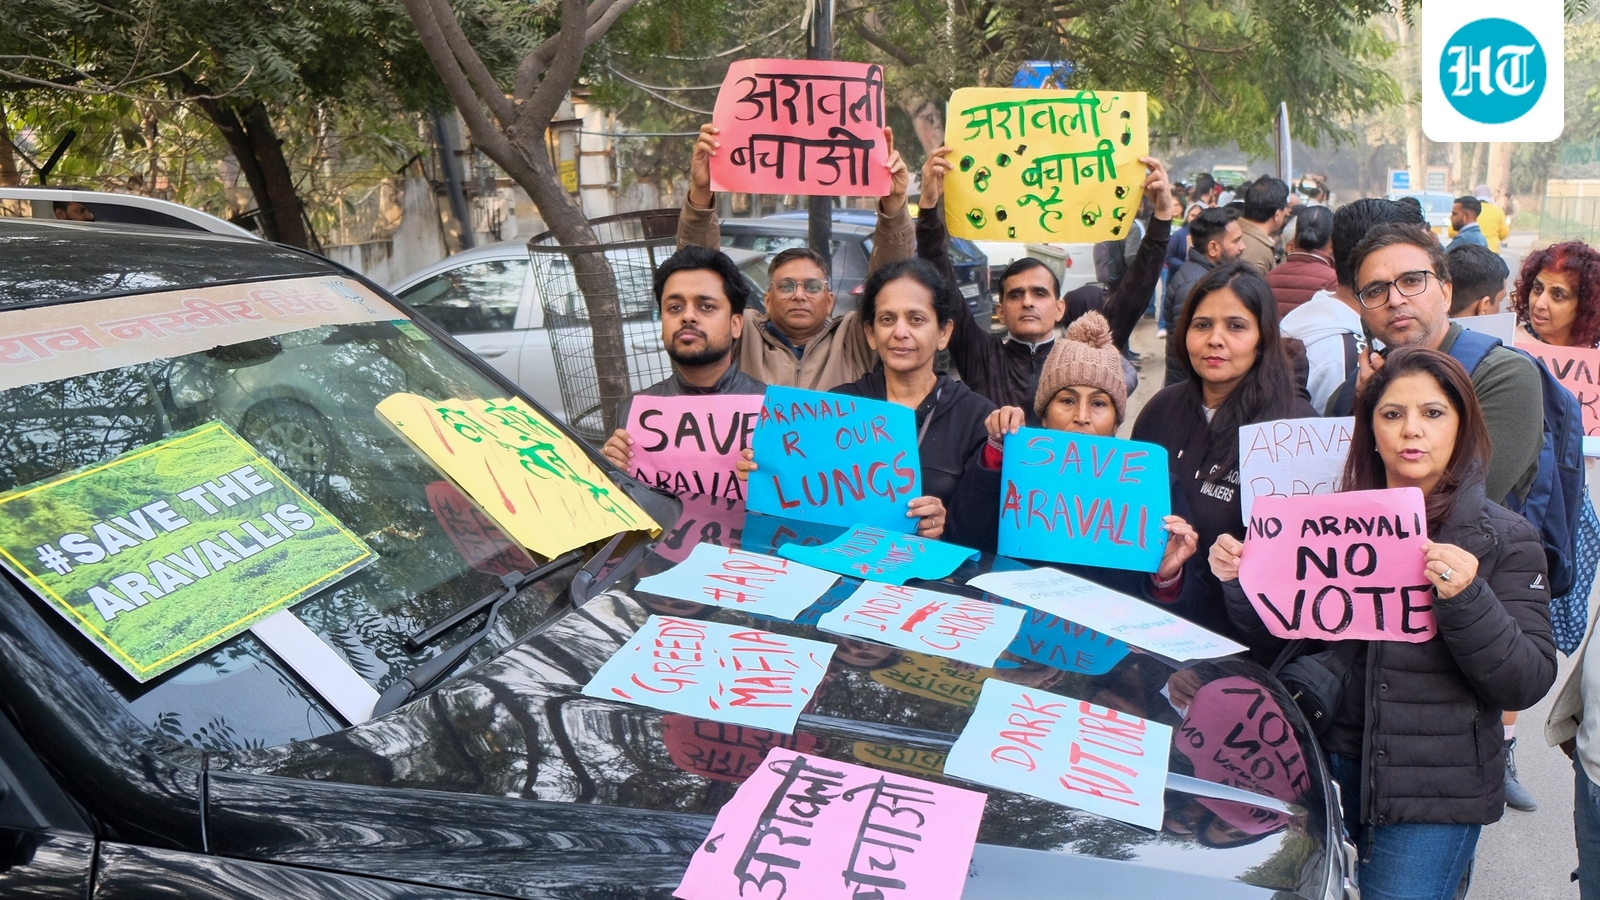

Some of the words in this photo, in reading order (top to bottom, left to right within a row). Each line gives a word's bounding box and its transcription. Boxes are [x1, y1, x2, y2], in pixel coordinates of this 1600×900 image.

[735, 64, 884, 130] अरावली
[960, 89, 1105, 143] अरावली
[730, 126, 875, 187] बचाओ
[1021, 138, 1117, 190] बचानी
[759, 398, 857, 430] ARAVALI
[782, 430, 807, 459] R
[835, 415, 894, 451] OUR
[771, 451, 916, 510] LUNGS
[1020, 436, 1149, 484] SAVE
[35, 499, 191, 576] #SAVE
[177, 464, 275, 516] THE
[1001, 479, 1147, 550] ARAVALI
[1200, 481, 1234, 502] WALKERS
[1249, 515, 1282, 541] NO
[1301, 512, 1421, 541] ARAVALI
[86, 503, 316, 622] ARAVALLIS
[702, 548, 788, 603] #AQI
[1296, 543, 1377, 582] NO
[1257, 585, 1434, 635] VOTE
[631, 617, 708, 693] GREEDY
[729, 631, 796, 708] MAFIA
[990, 693, 1067, 772] DARK
[1058, 701, 1147, 807] FUTURE
